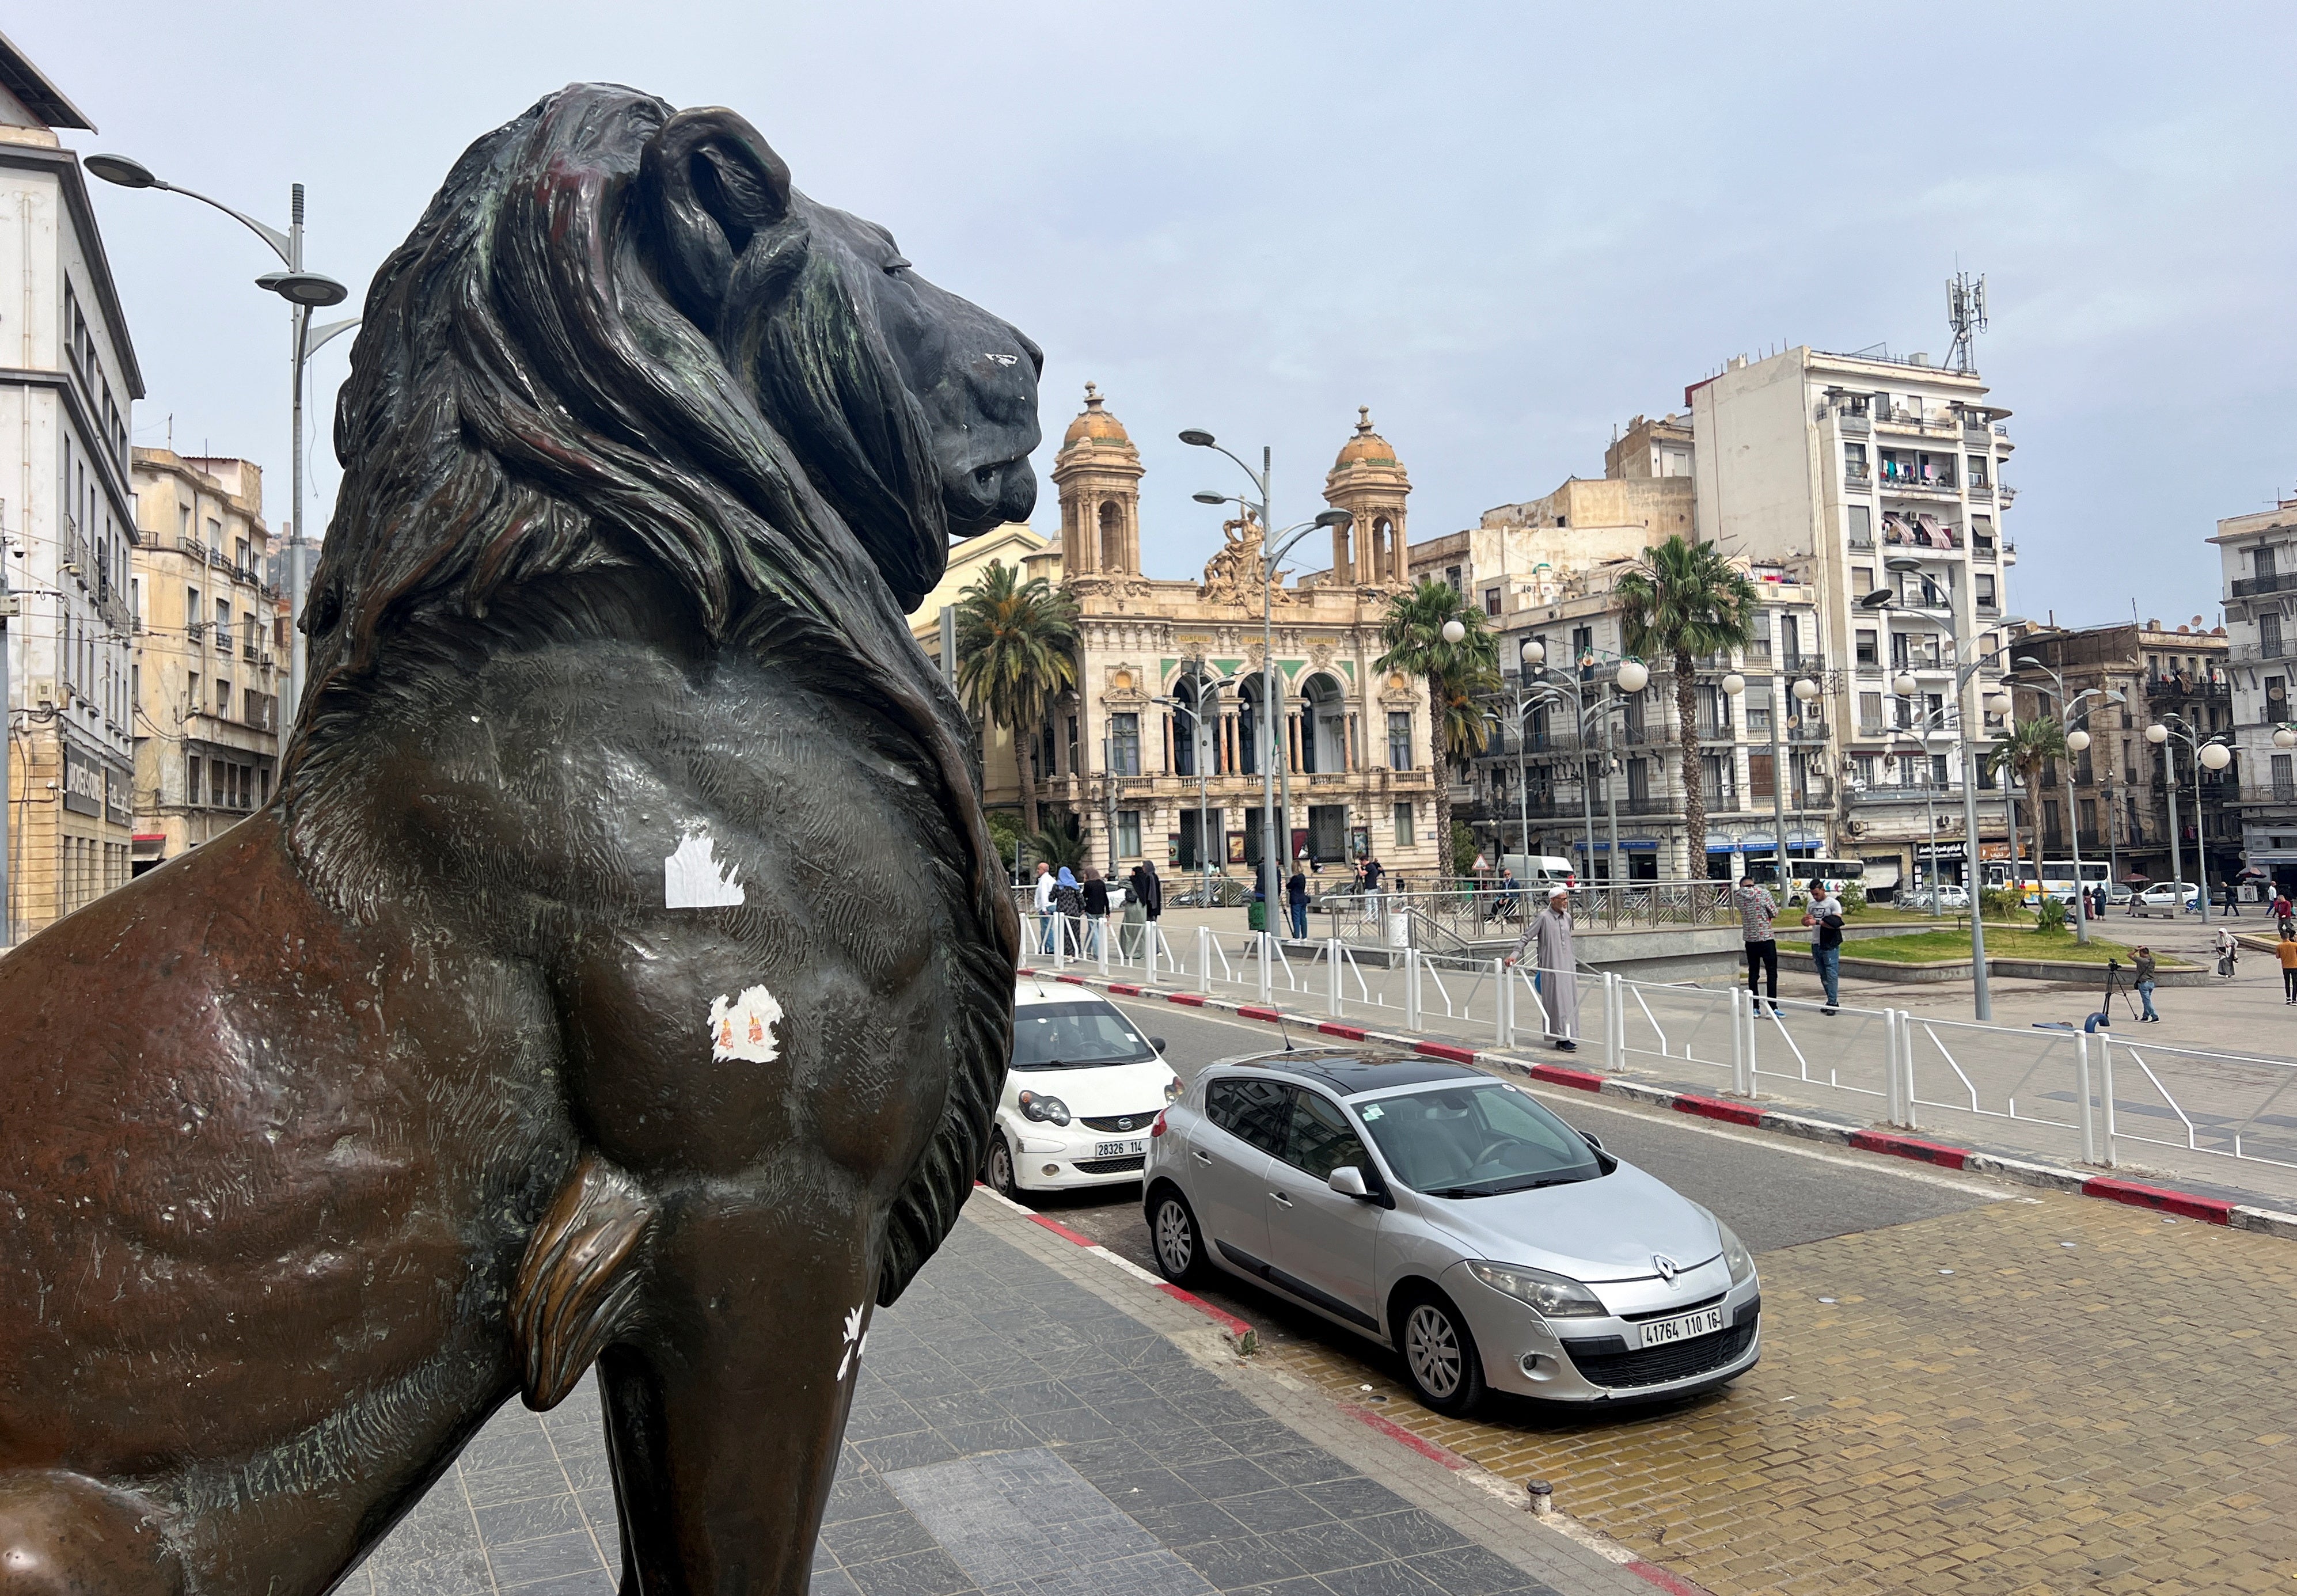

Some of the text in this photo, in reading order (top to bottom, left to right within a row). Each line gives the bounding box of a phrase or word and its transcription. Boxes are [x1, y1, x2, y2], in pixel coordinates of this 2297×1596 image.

[1098, 1141, 1142, 1156] 28326 114
[1646, 1312, 1718, 1343] 41764 110 16
